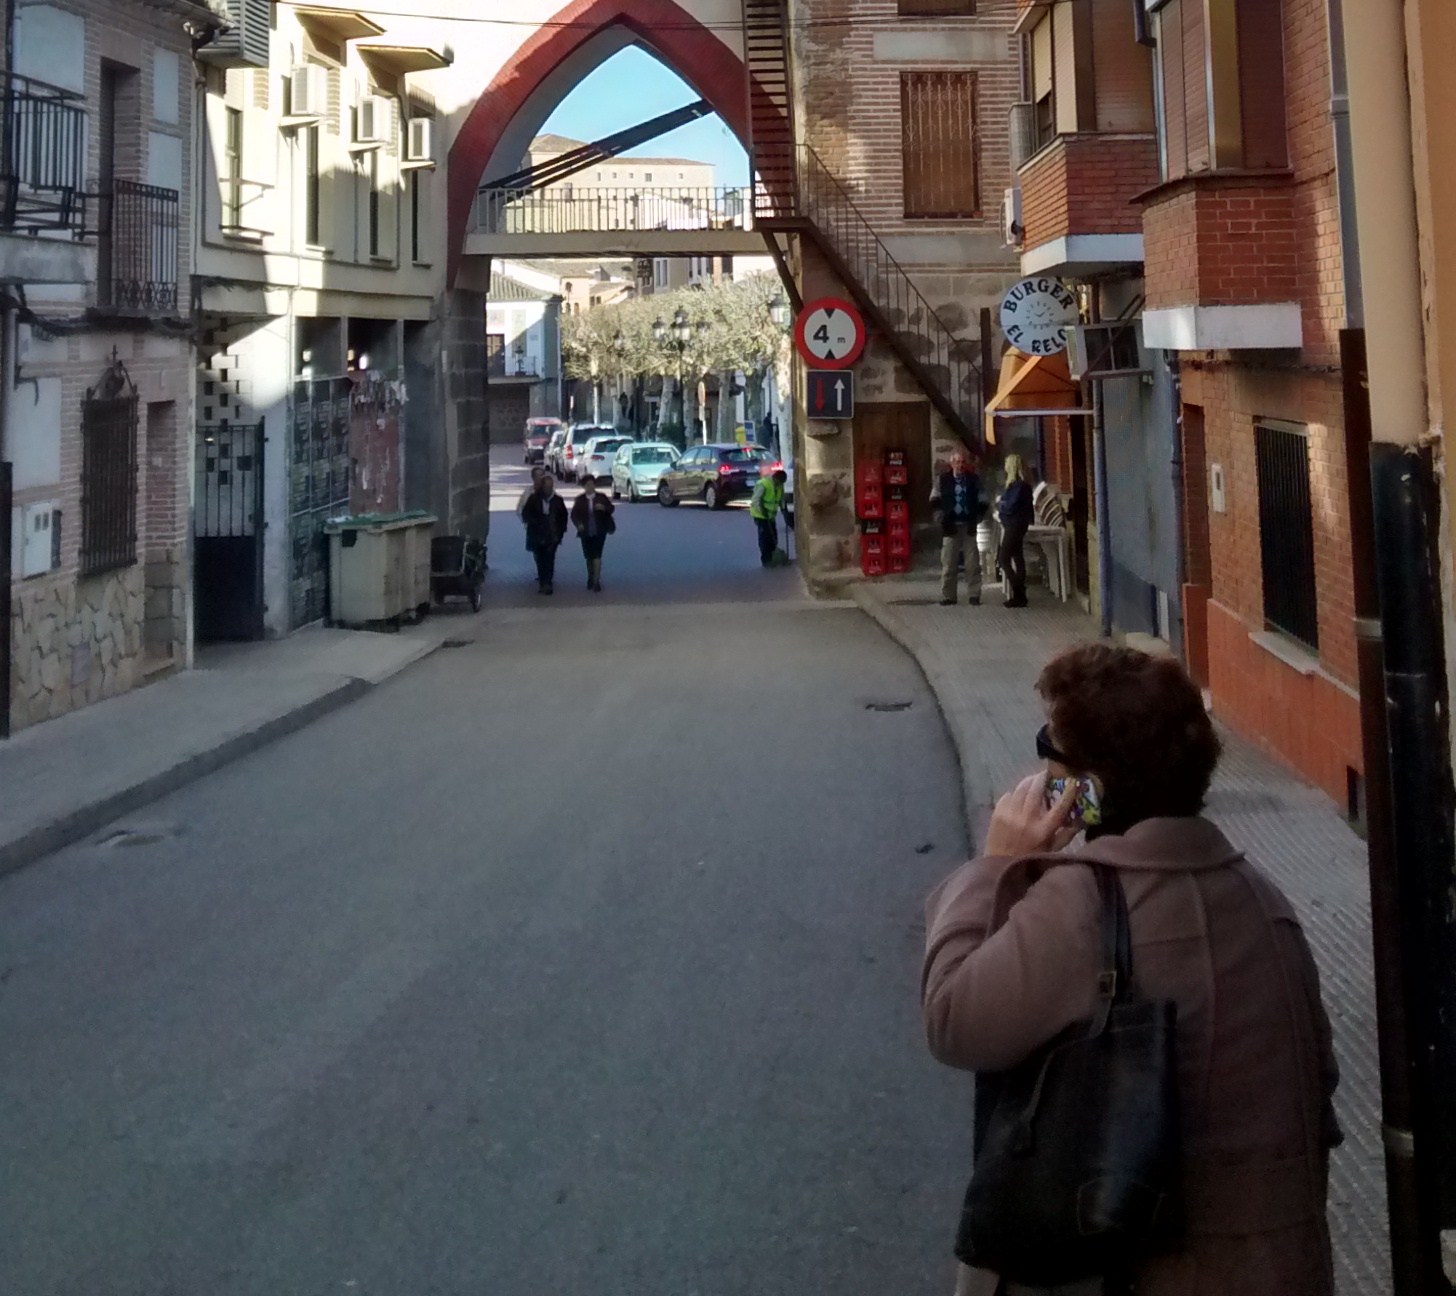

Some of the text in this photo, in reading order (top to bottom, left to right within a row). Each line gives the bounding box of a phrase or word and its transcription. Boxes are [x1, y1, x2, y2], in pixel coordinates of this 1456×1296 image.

[1003, 278, 1074, 313] BURGER
[813, 324, 829, 344] 4
[1007, 324, 1023, 343] EL
[1031, 328, 1067, 353] RELO
